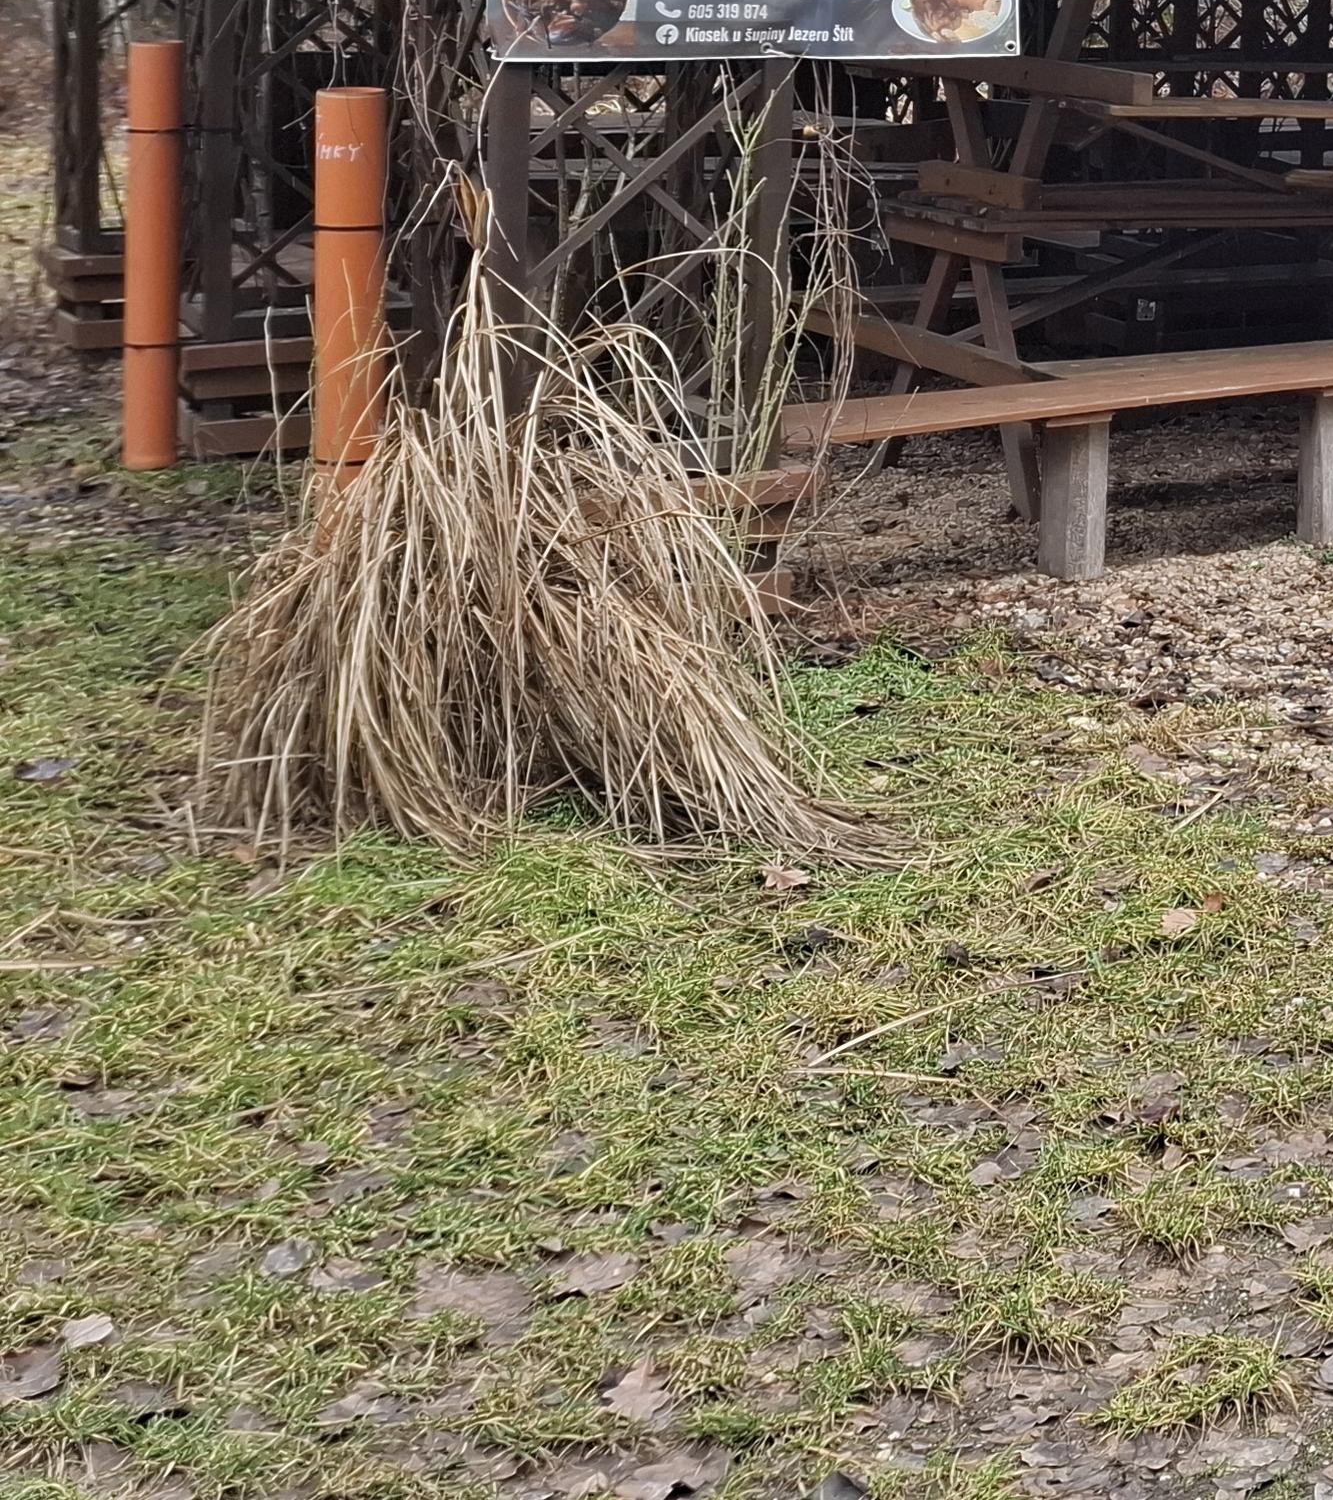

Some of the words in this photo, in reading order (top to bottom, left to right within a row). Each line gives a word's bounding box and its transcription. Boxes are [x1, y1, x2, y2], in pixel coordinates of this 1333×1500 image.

[688, 4, 713, 19] 605
[716, 4, 739, 19] 319
[744, 4, 768, 19] 874
[686, 27, 729, 42] Kiosek
[733, 31, 741, 42] u
[745, 28, 786, 44] šupiny
[788, 26, 829, 42] Jezero
[832, 24, 854, 42] Štít
